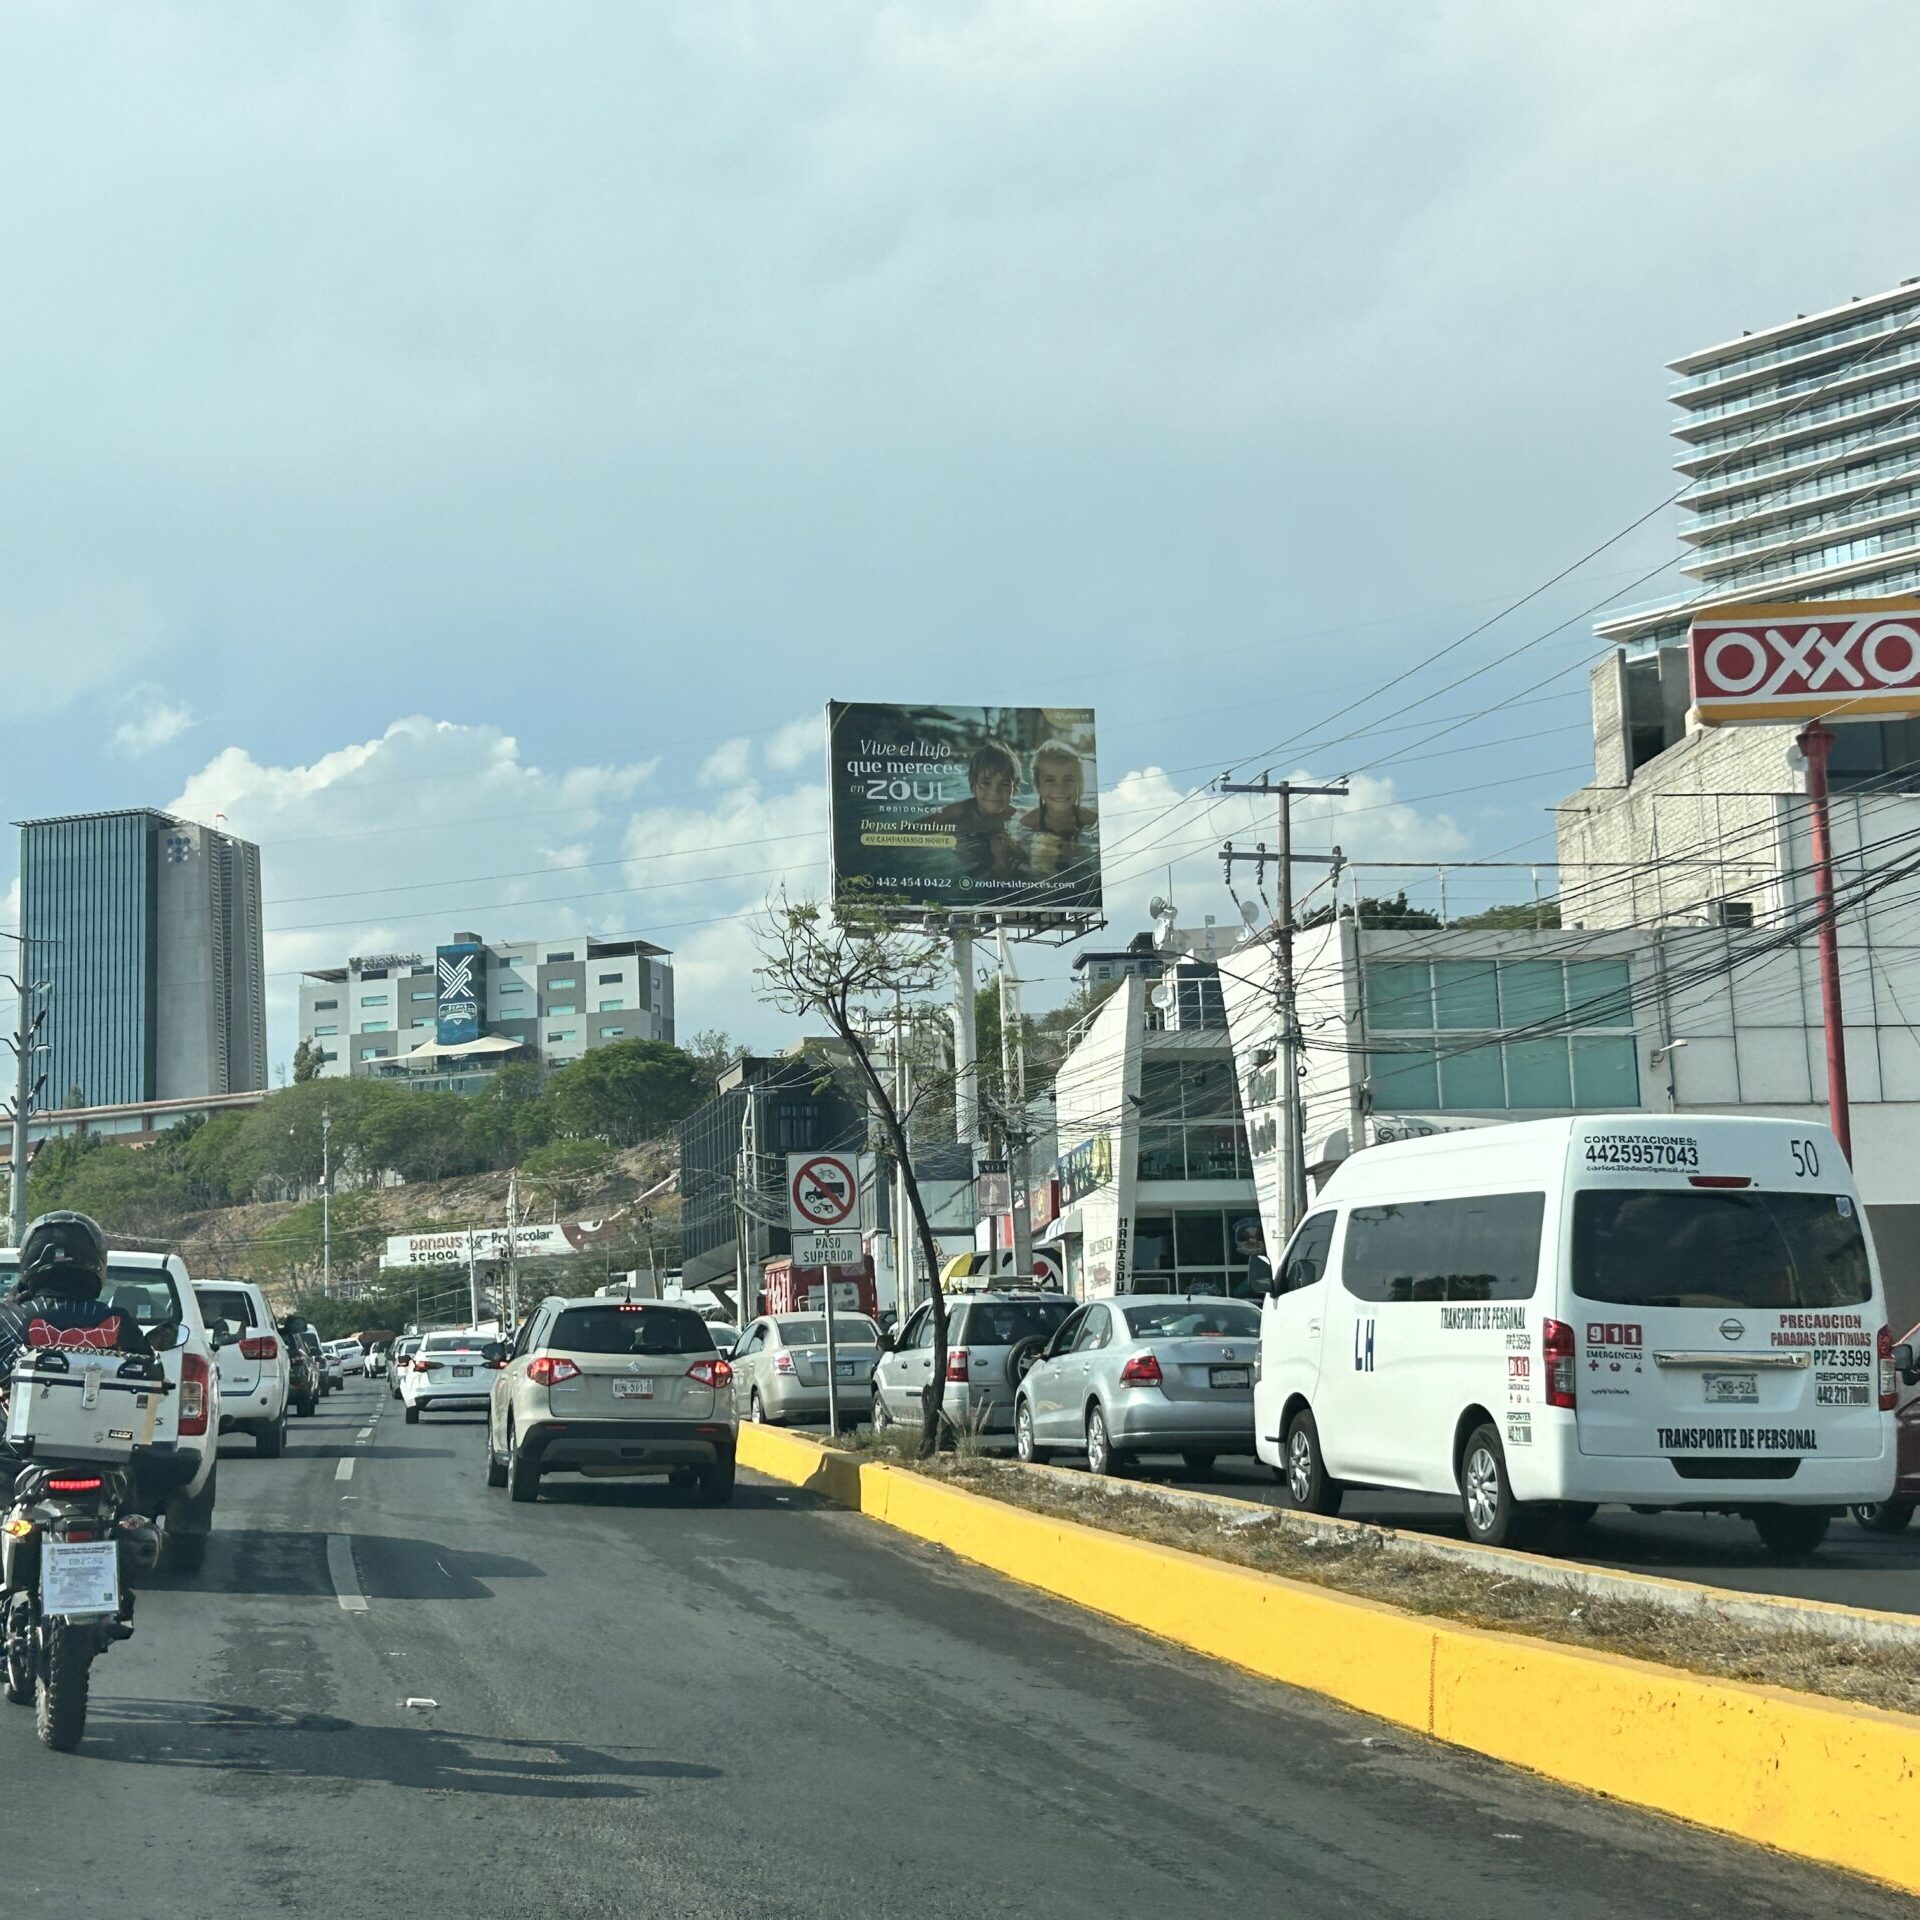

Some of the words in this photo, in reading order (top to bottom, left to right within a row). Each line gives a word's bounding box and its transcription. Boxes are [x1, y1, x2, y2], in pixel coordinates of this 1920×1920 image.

[1704, 623, 1920, 695] OXXO
[860, 739, 896, 756] Vive
[899, 741, 915, 757] el
[919, 741, 951, 760] lujo
[847, 760, 882, 777] que
[886, 761, 962, 775] mereces
[850, 784, 865, 793] en
[860, 819, 897, 832] Depas
[900, 820, 957, 833] Premium
[876, 876, 898, 887] 442
[900, 877, 921, 887] 454
[923, 878, 952, 888] 0422
[1585, 1144, 1699, 1166] 4425957043
[1790, 1139, 1820, 1177] 50
[816, 1238, 841, 1249] PASO
[409, 1250, 461, 1262] SCHOOL
[803, 1250, 853, 1263] SUPERIOR
[1482, 1307, 1491, 1330] DE
[1780, 1314, 1862, 1329] PRECAUCION
[1588, 1325, 1638, 1343] 911
[1770, 1331, 1816, 1346] PARADAS
[1818, 1332, 1872, 1347] CONTINUAS
[1586, 1350, 1643, 1360] EMERGENCIAS
[1813, 1349, 1871, 1367] PPZ-3599
[1816, 1372, 1869, 1382] REPORTES
[1657, 1428, 1737, 1449] TRANSPORTE
[1739, 1428, 1754, 1449] DE
[1756, 1429, 1817, 1450] PERSONAL
